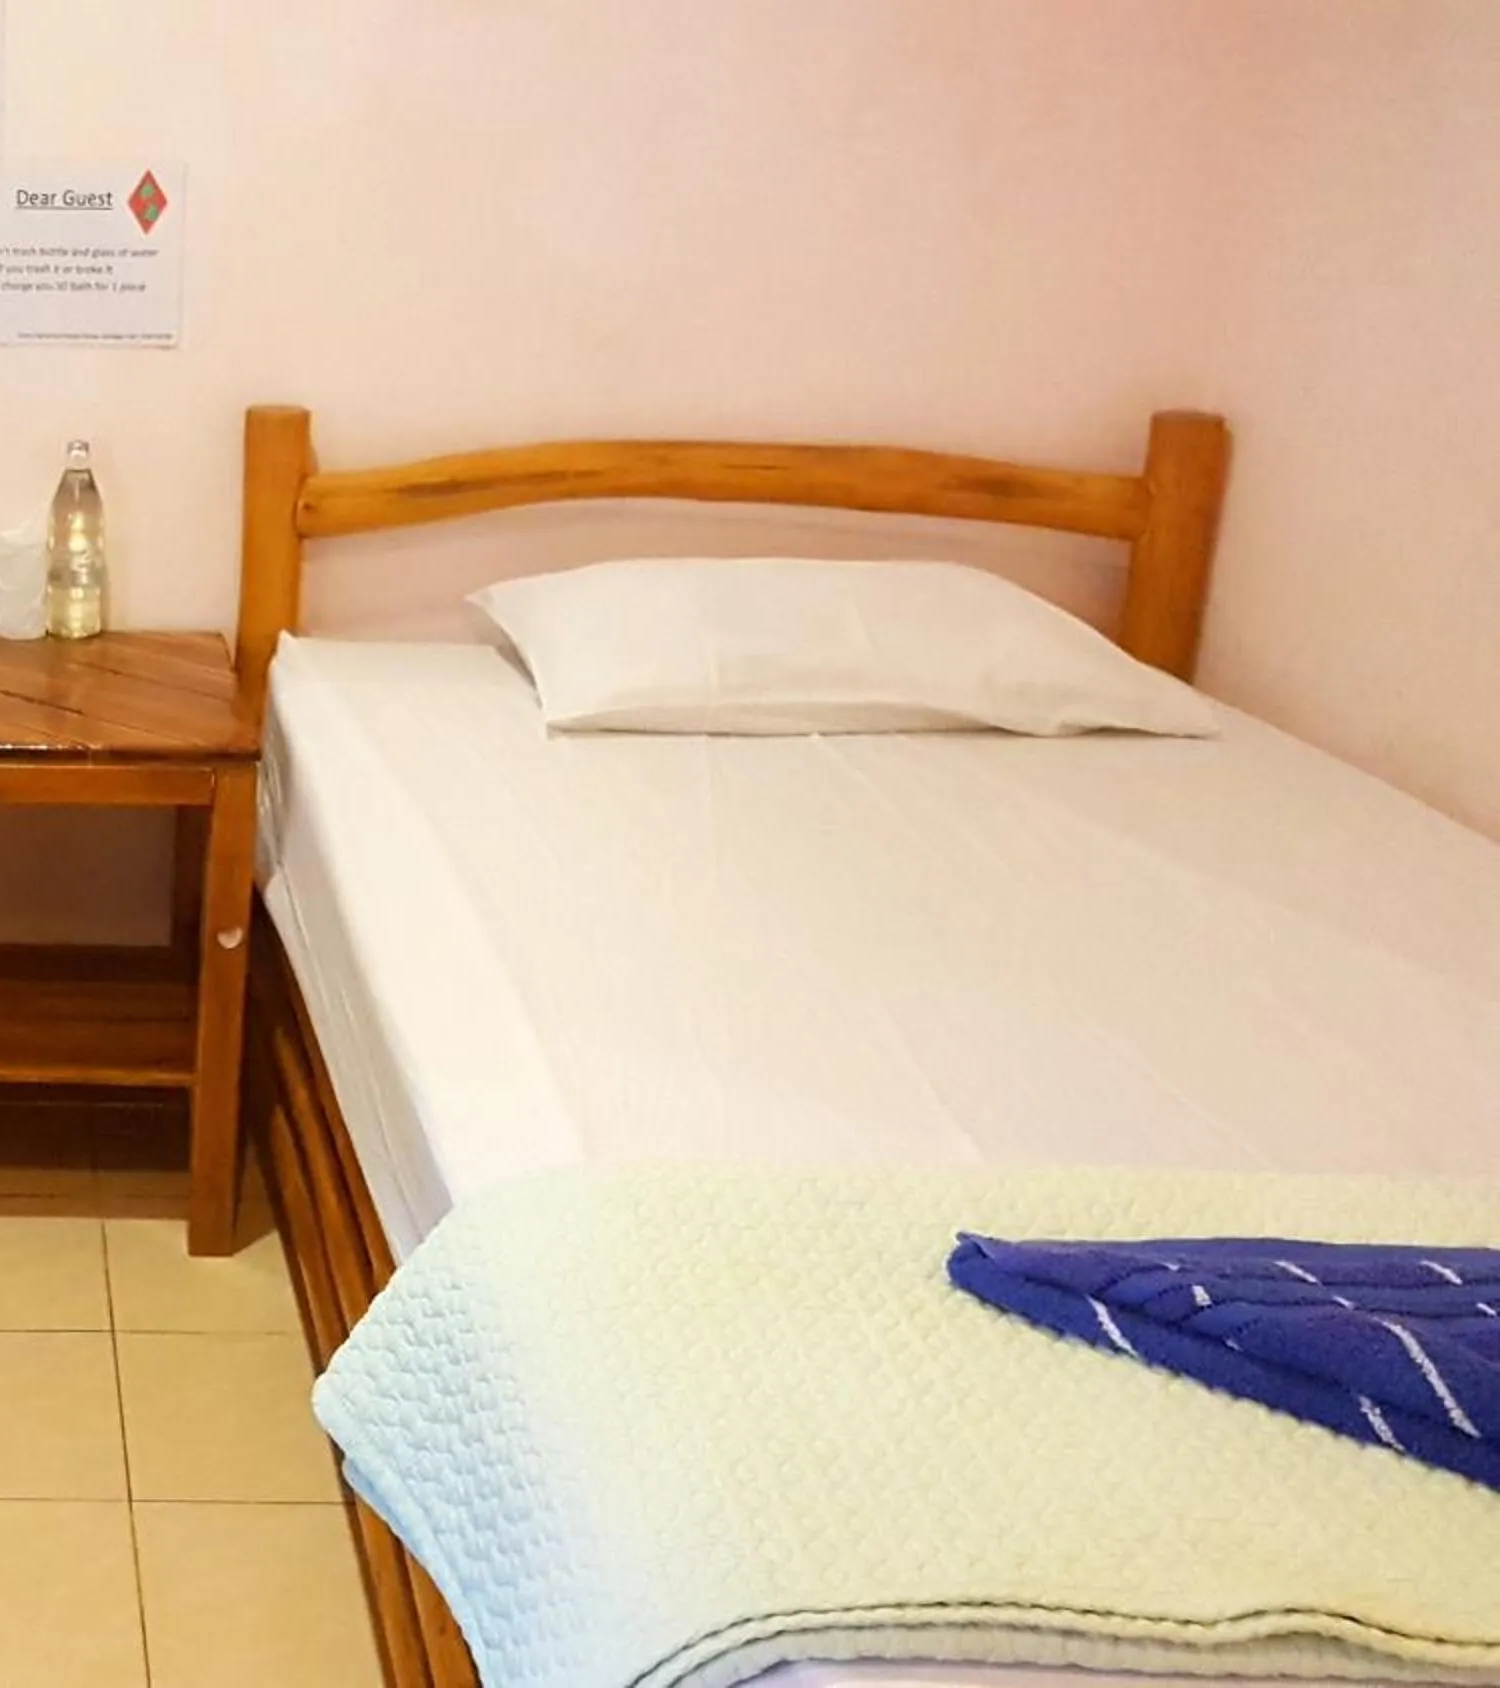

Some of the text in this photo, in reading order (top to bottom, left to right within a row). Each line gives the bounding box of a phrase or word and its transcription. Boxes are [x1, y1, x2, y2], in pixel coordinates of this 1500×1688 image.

[15, 188, 114, 208] Dear Guest
[72, 247, 90, 257] and
